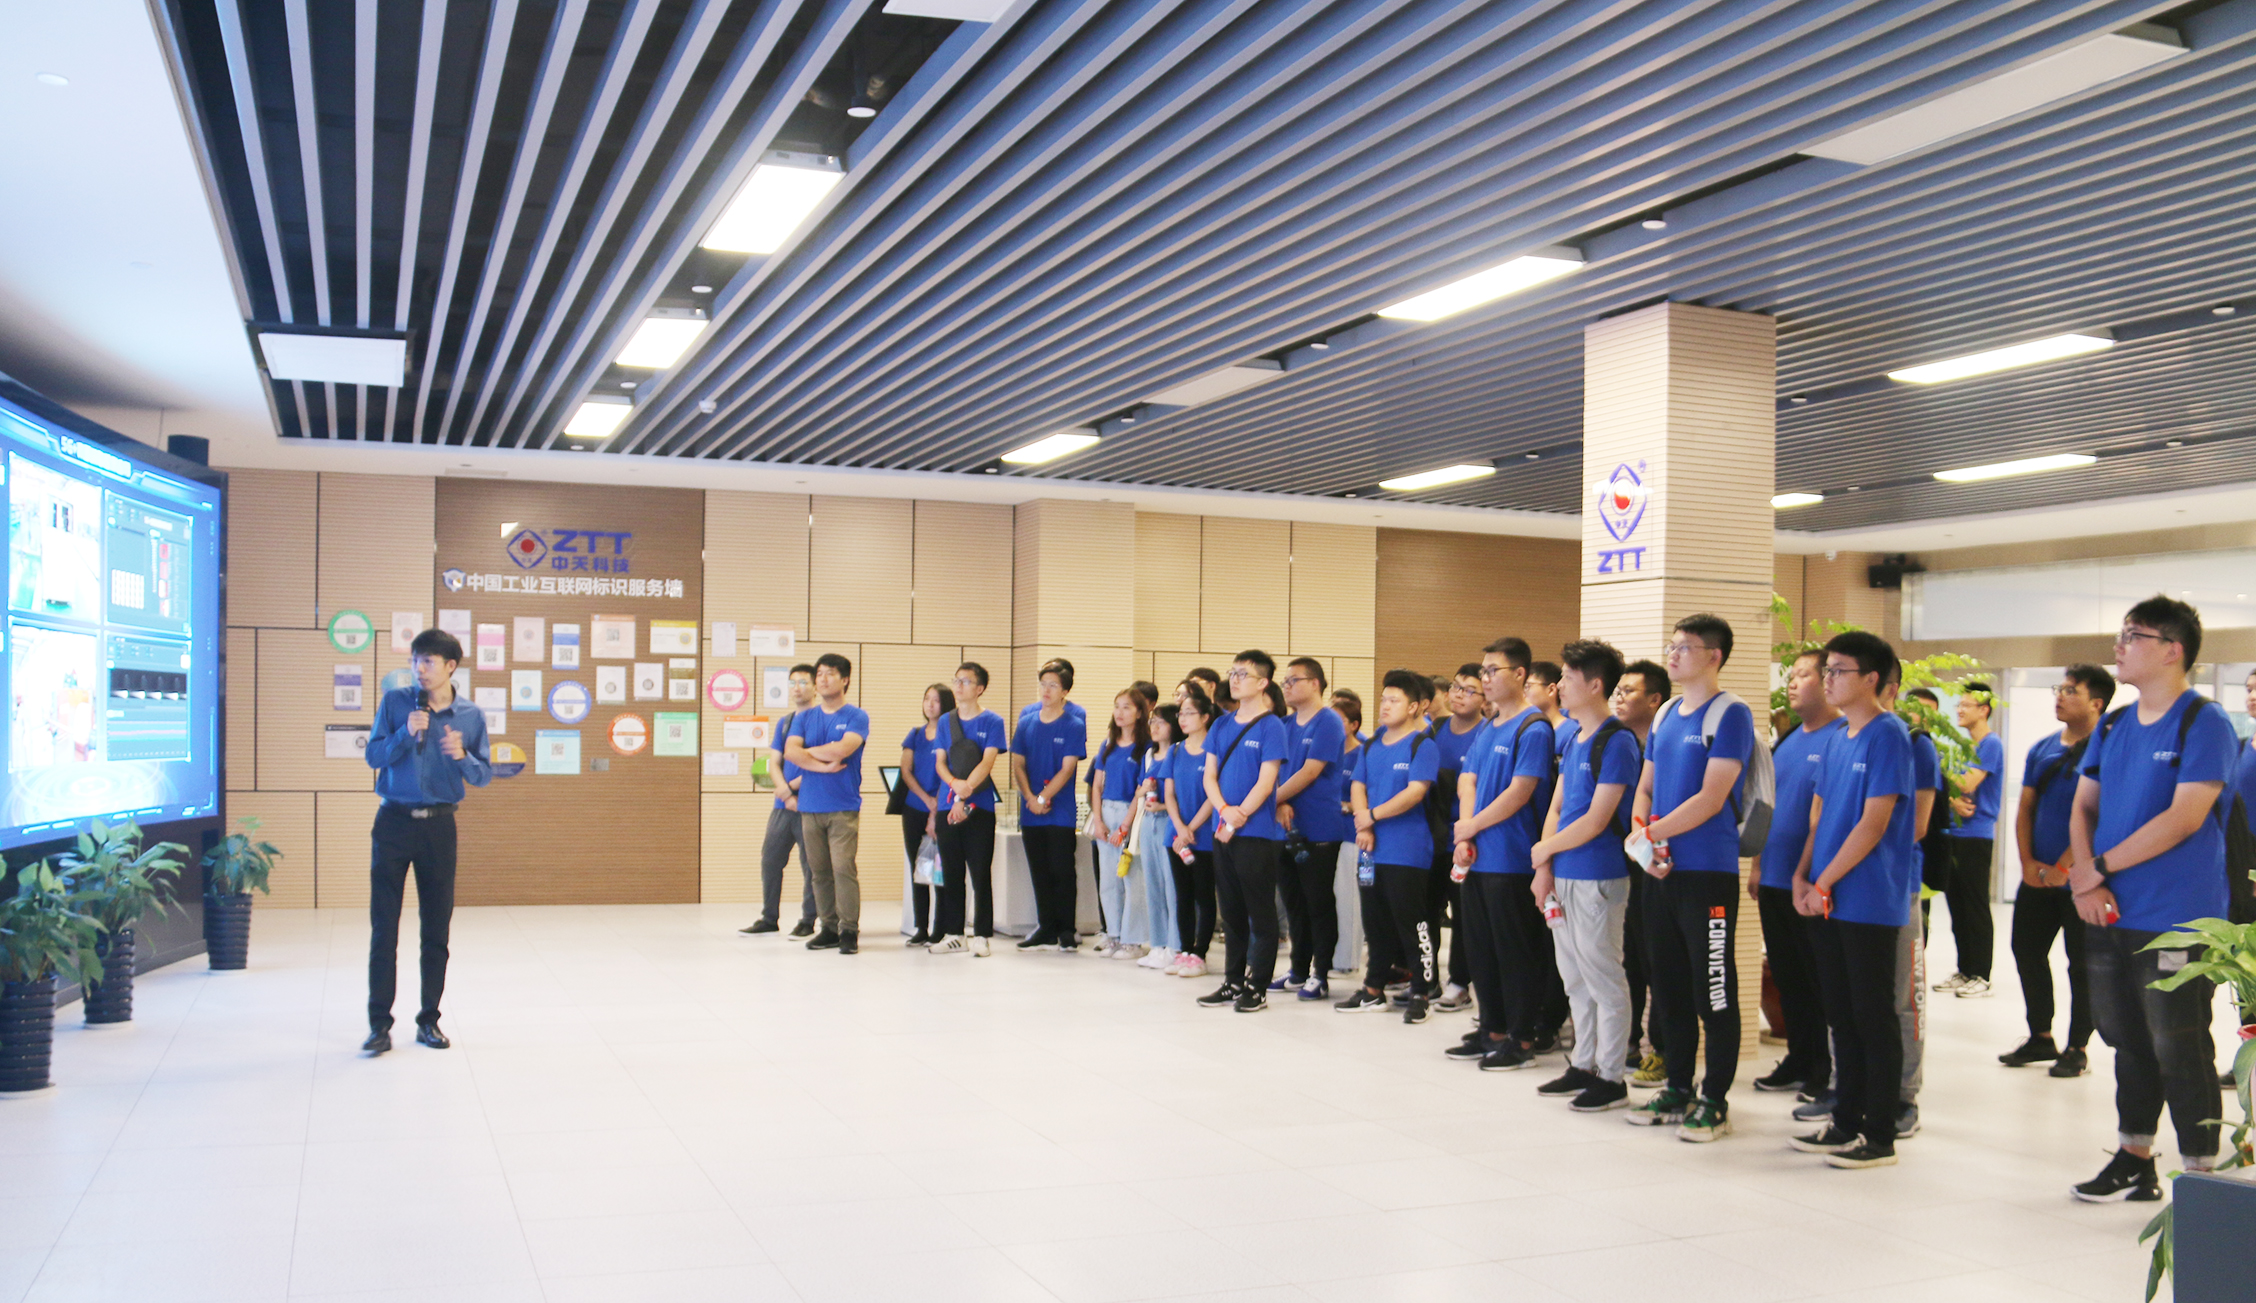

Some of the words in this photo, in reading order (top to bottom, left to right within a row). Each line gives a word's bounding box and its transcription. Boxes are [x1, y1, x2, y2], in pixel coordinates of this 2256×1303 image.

[552, 529, 632, 554] ZTT
[551, 555, 630, 573] 中天科技
[1597, 546, 1647, 573] ZTT
[466, 573, 684, 598] 中国工业互联网标识服务墙
[1416, 921, 1433, 982] adidas
[1708, 918, 1728, 1012] CONVICTION
[1914, 938, 1924, 977] NEW
